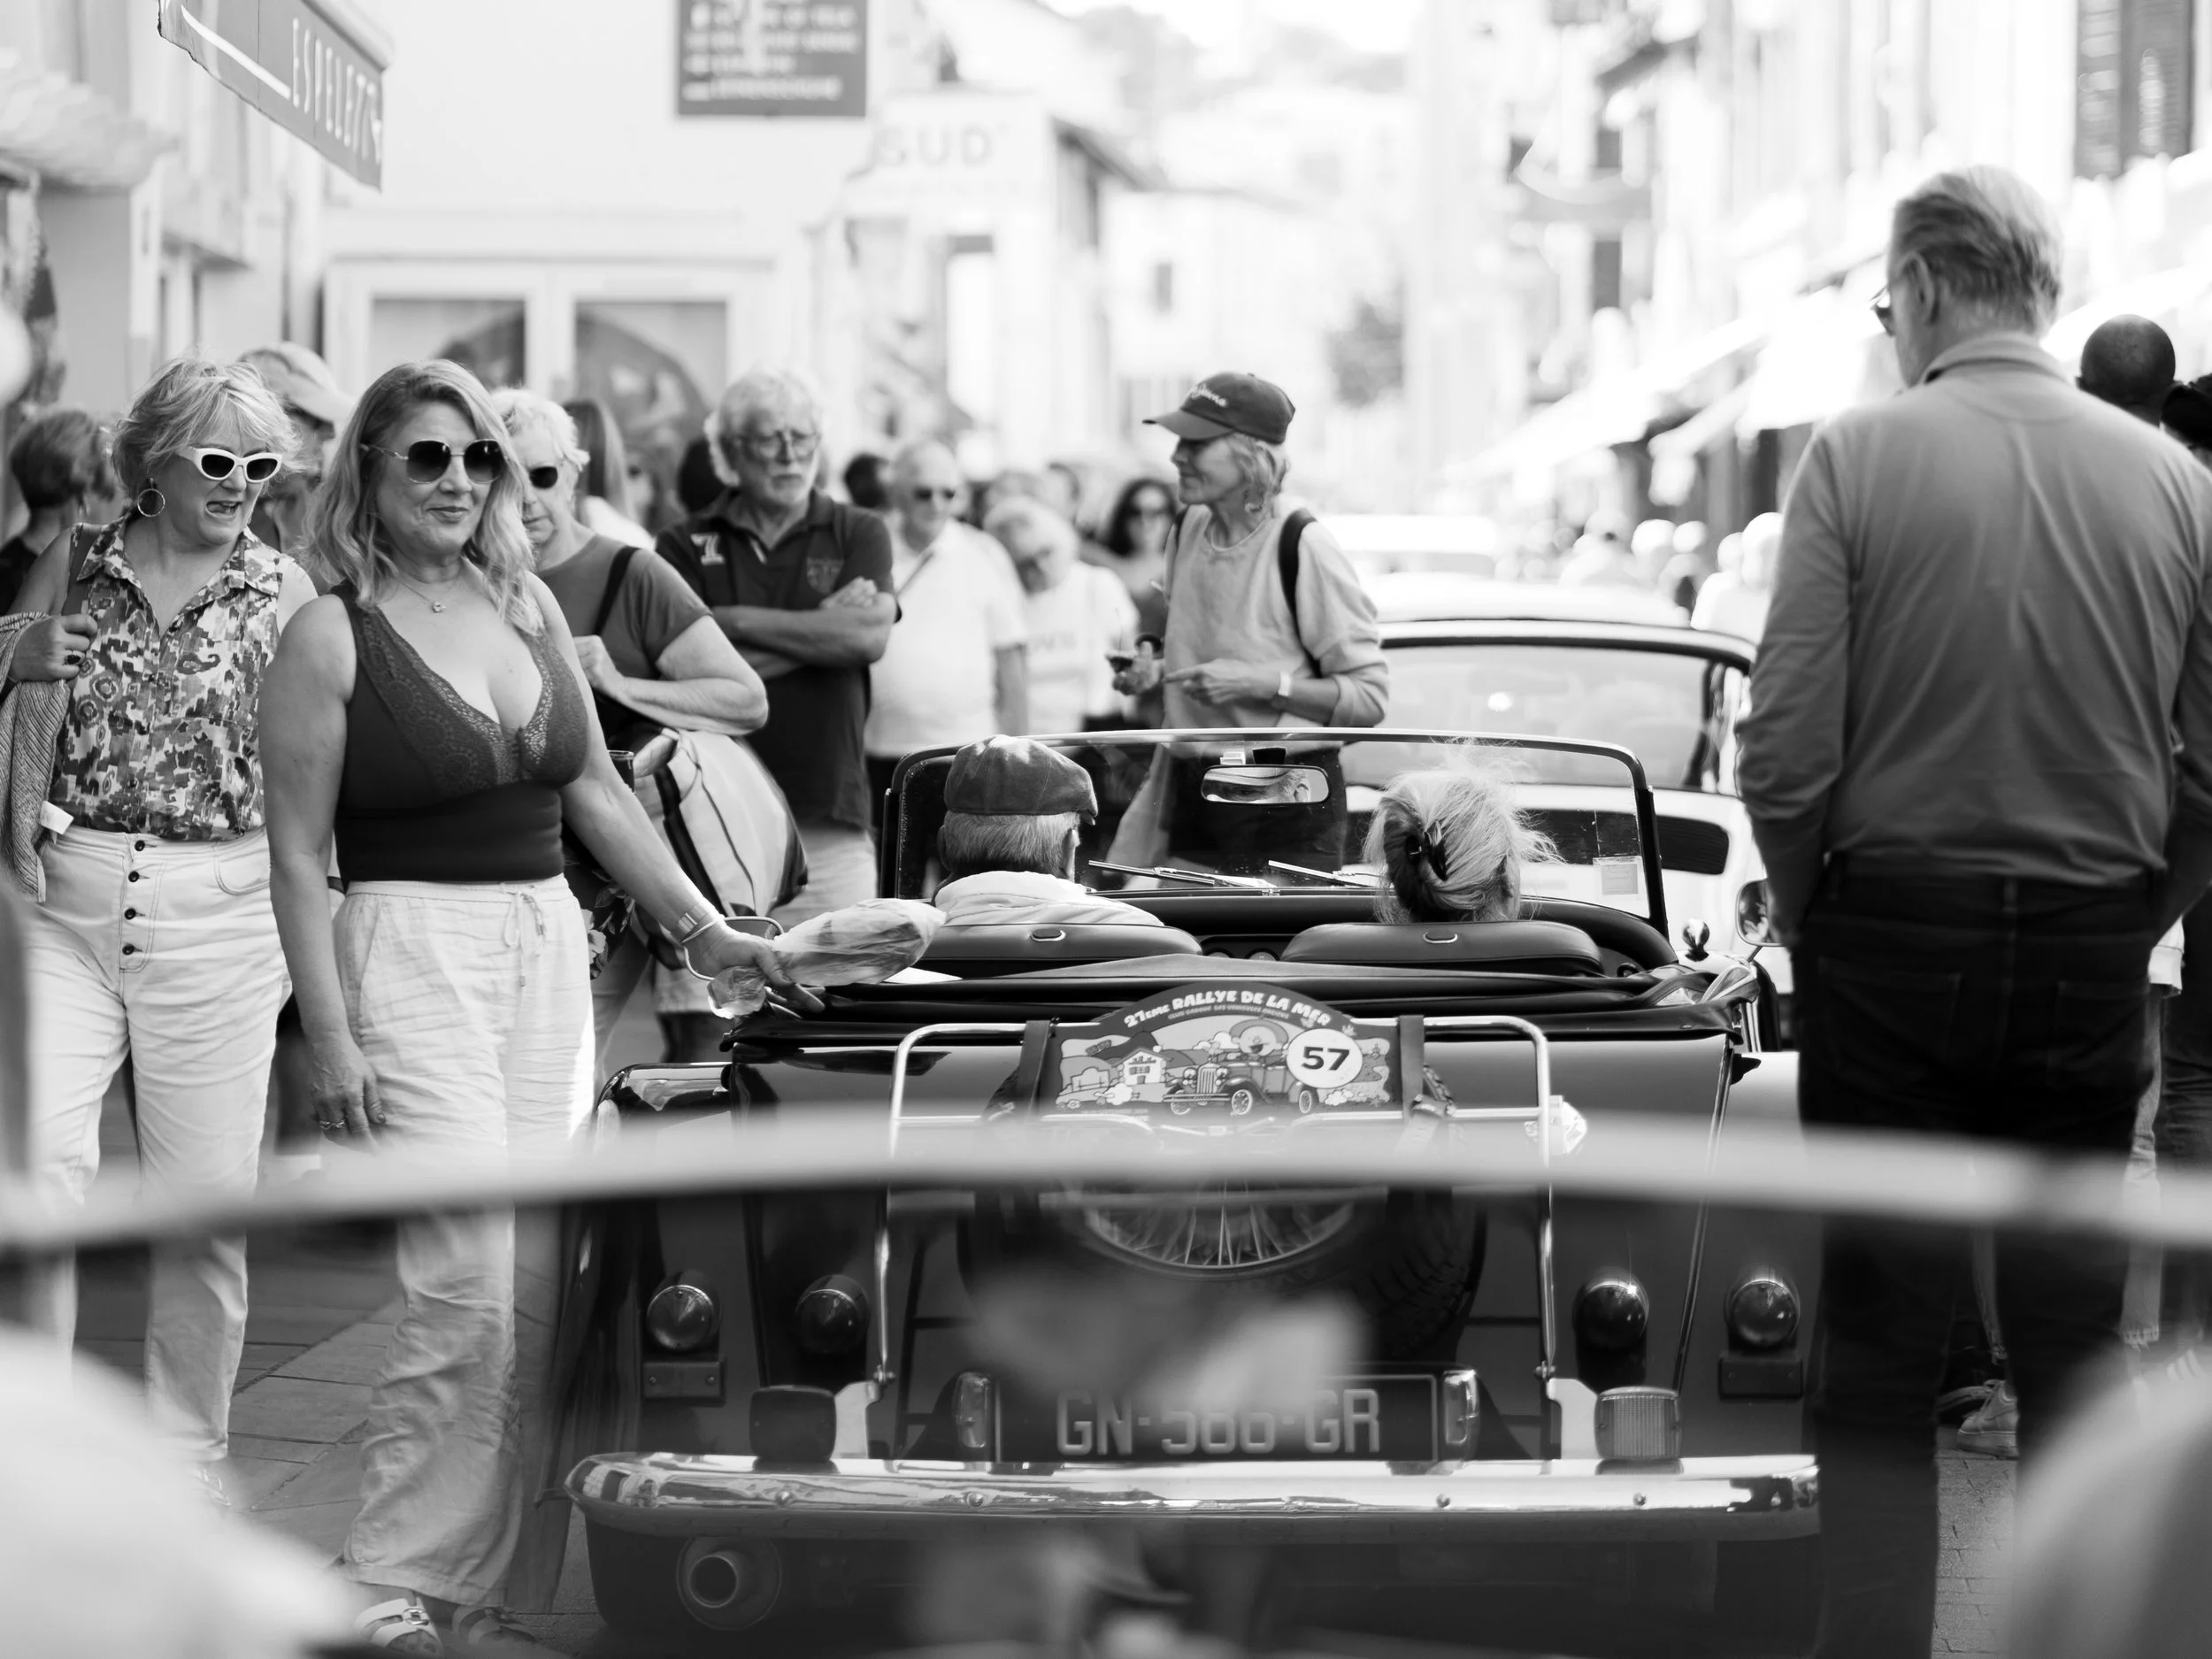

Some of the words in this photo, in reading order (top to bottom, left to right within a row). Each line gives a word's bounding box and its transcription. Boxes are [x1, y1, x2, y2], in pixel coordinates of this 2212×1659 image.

[1171, 990, 1237, 1010] RALLYE
[1240, 990, 1265, 1004] DE
[1266, 994, 1290, 1010] LA
[1291, 1002, 1332, 1025] MER
[1301, 1046, 1349, 1071] 57
